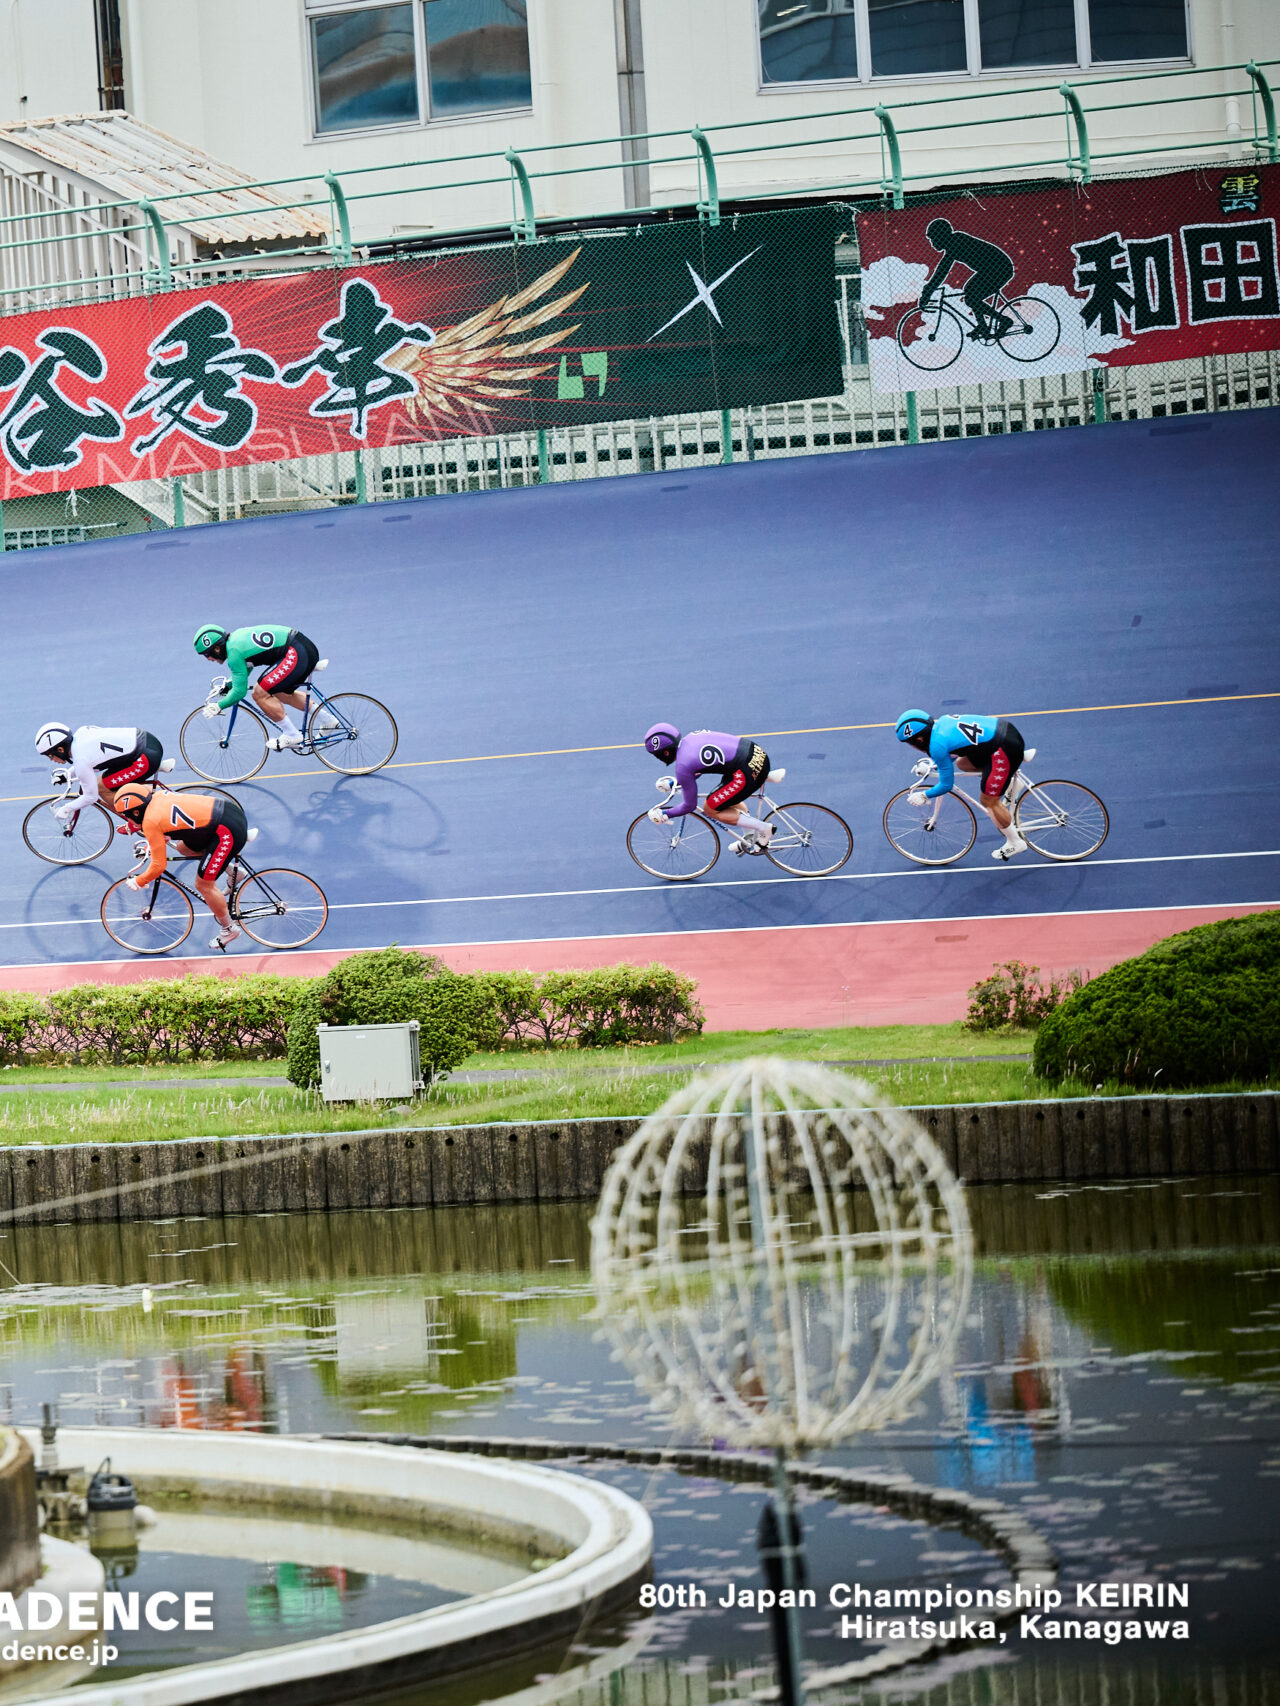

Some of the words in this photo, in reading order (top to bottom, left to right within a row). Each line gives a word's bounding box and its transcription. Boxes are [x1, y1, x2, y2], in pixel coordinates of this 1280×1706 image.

[1071, 217, 1280, 338] 和田
[202, 634, 211, 648] 6
[251, 630, 276, 650] 6
[903, 723, 913, 737] 4
[957, 722, 984, 745] 4
[46, 734, 52, 746] 1
[100, 741, 124, 754] 1
[651, 736, 660, 751] 9
[699, 744, 725, 767] 9
[122, 797, 130, 809] 7
[170, 803, 196, 829] 7
